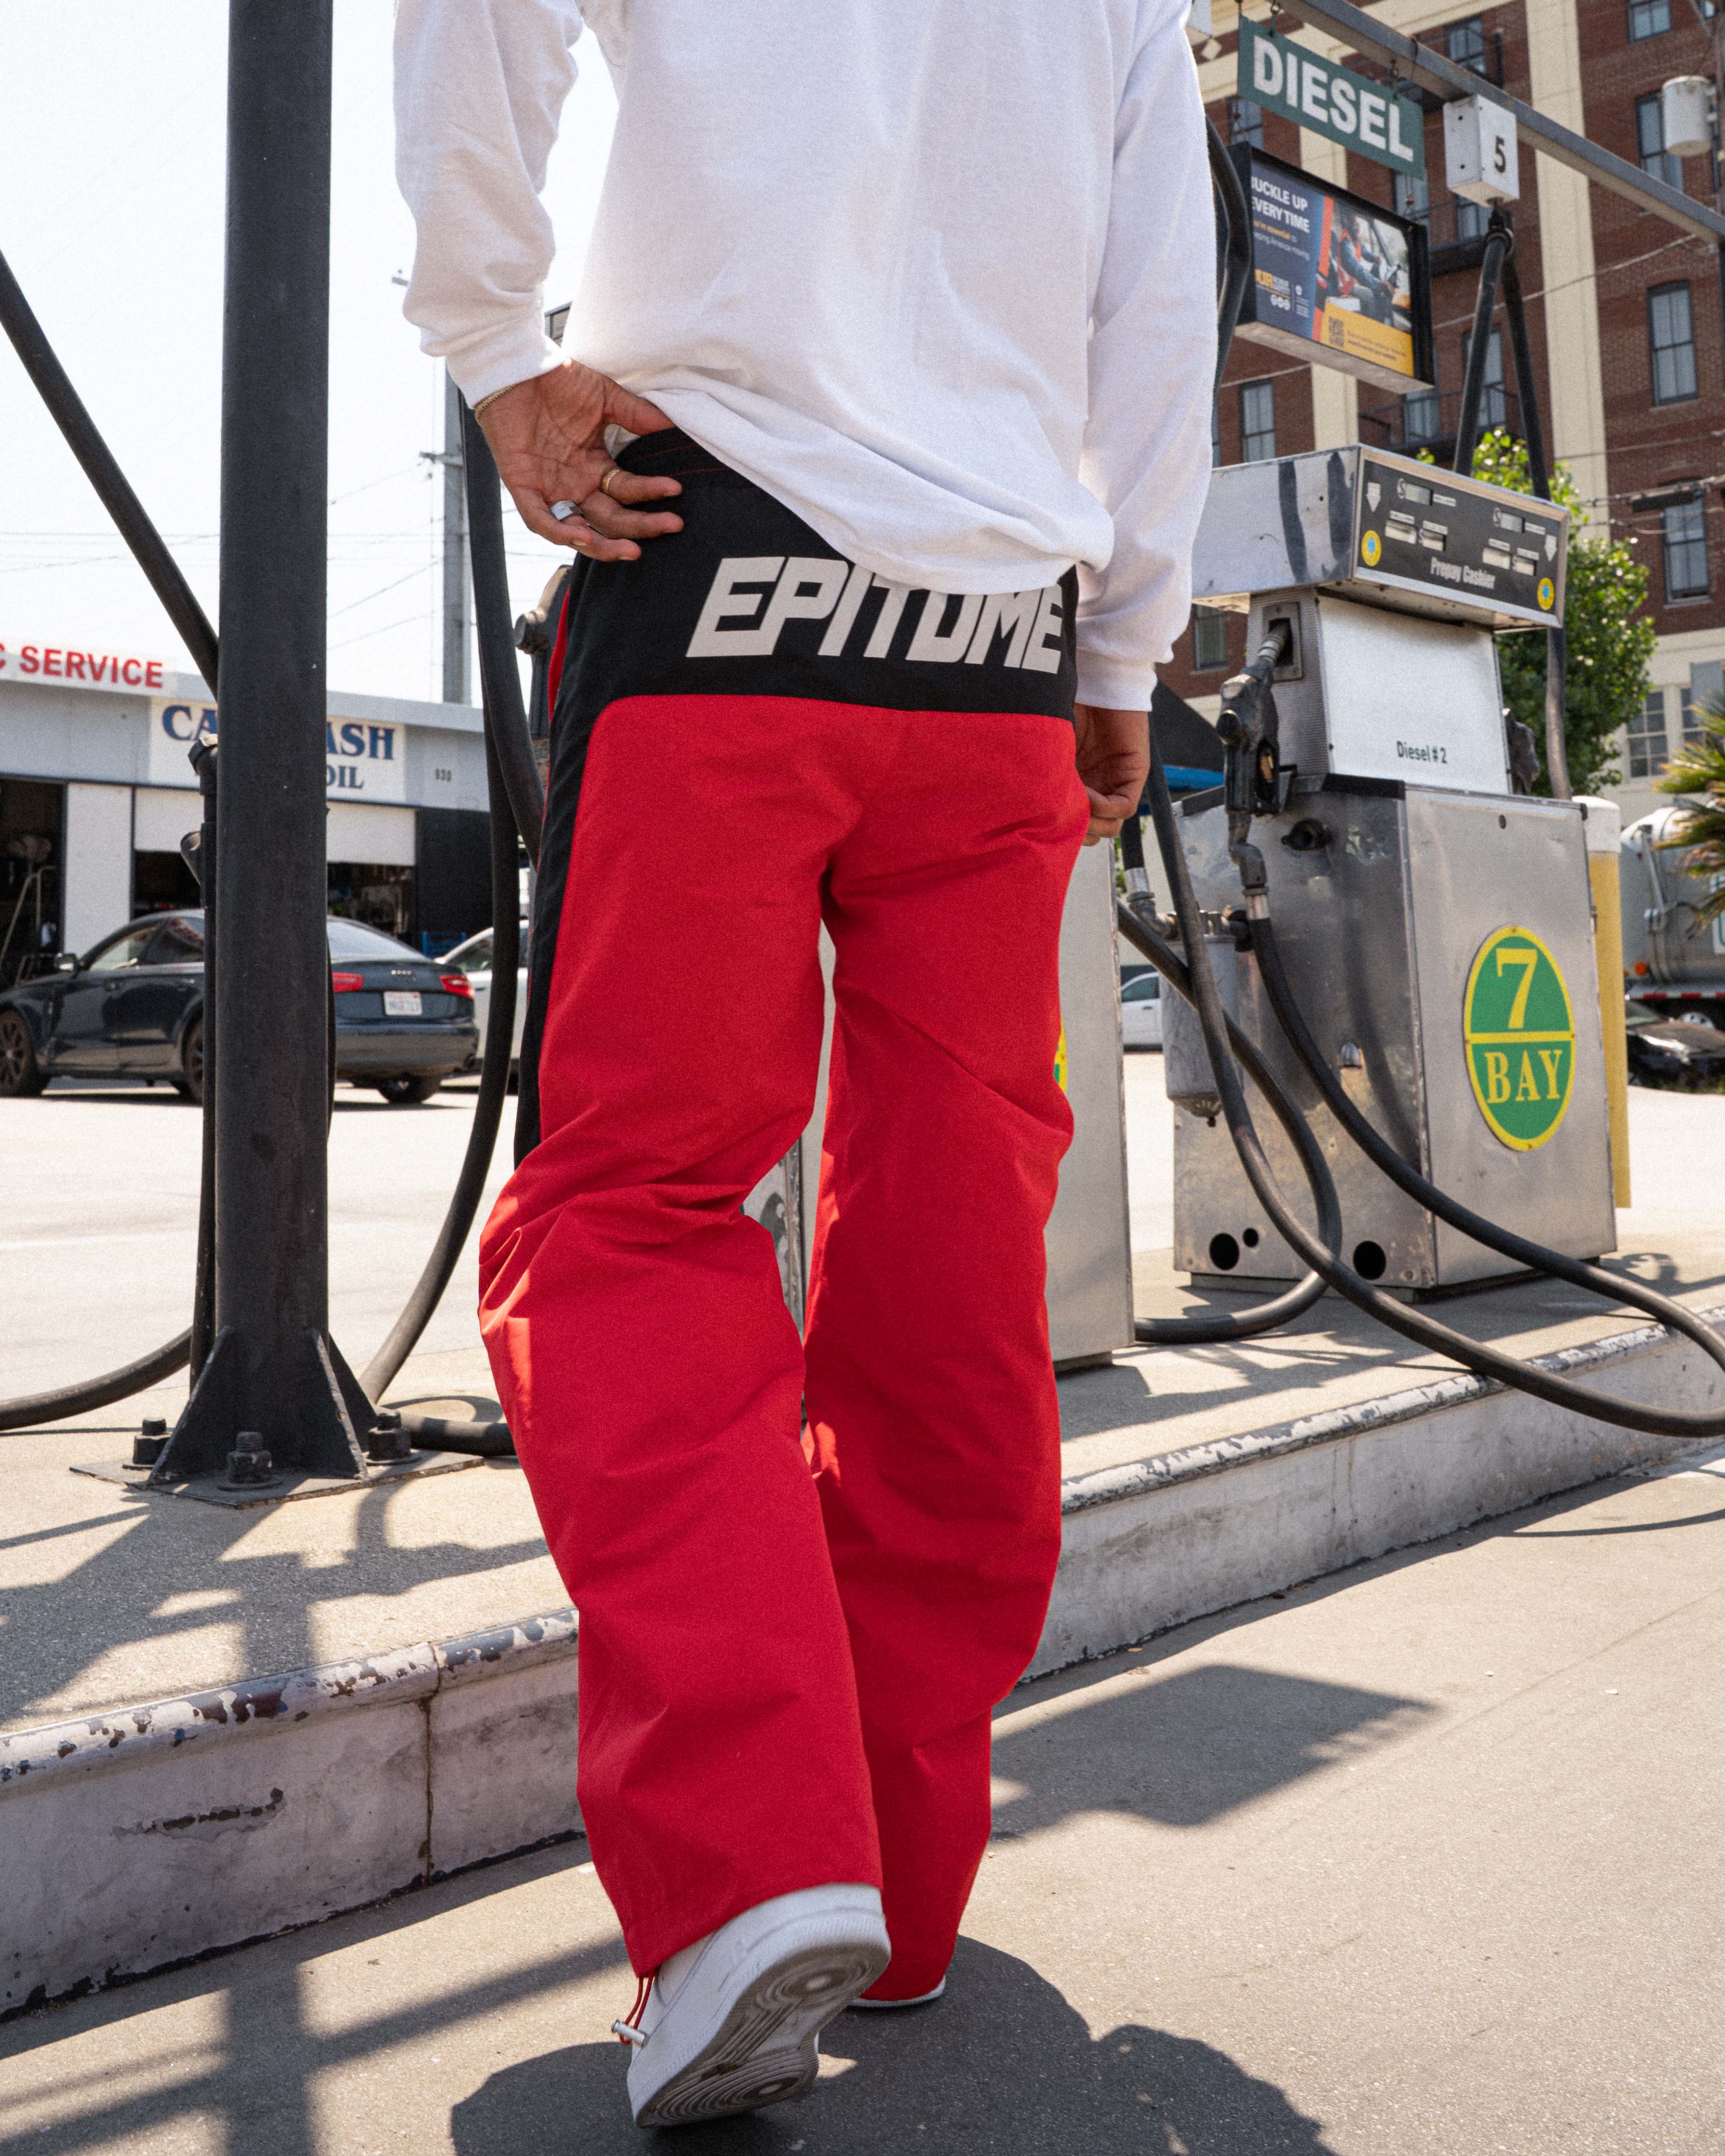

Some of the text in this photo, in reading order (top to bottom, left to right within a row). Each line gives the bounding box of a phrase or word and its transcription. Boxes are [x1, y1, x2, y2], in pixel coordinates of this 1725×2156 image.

[1253, 35, 1414, 163] DIESEL
[1493, 135, 1507, 174] 5
[1283, 209, 1310, 233] TIME
[1292, 194, 1308, 211] UP
[1430, 556, 1496, 590] Prepay Cashier
[686, 556, 1063, 674] EPITOME
[19, 645, 163, 689] SERVICE
[161, 705, 218, 742] CA
[1396, 741, 1431, 762] Diesel
[1495, 947, 1538, 1029] 7
[1484, 1049, 1563, 1104] BAY
